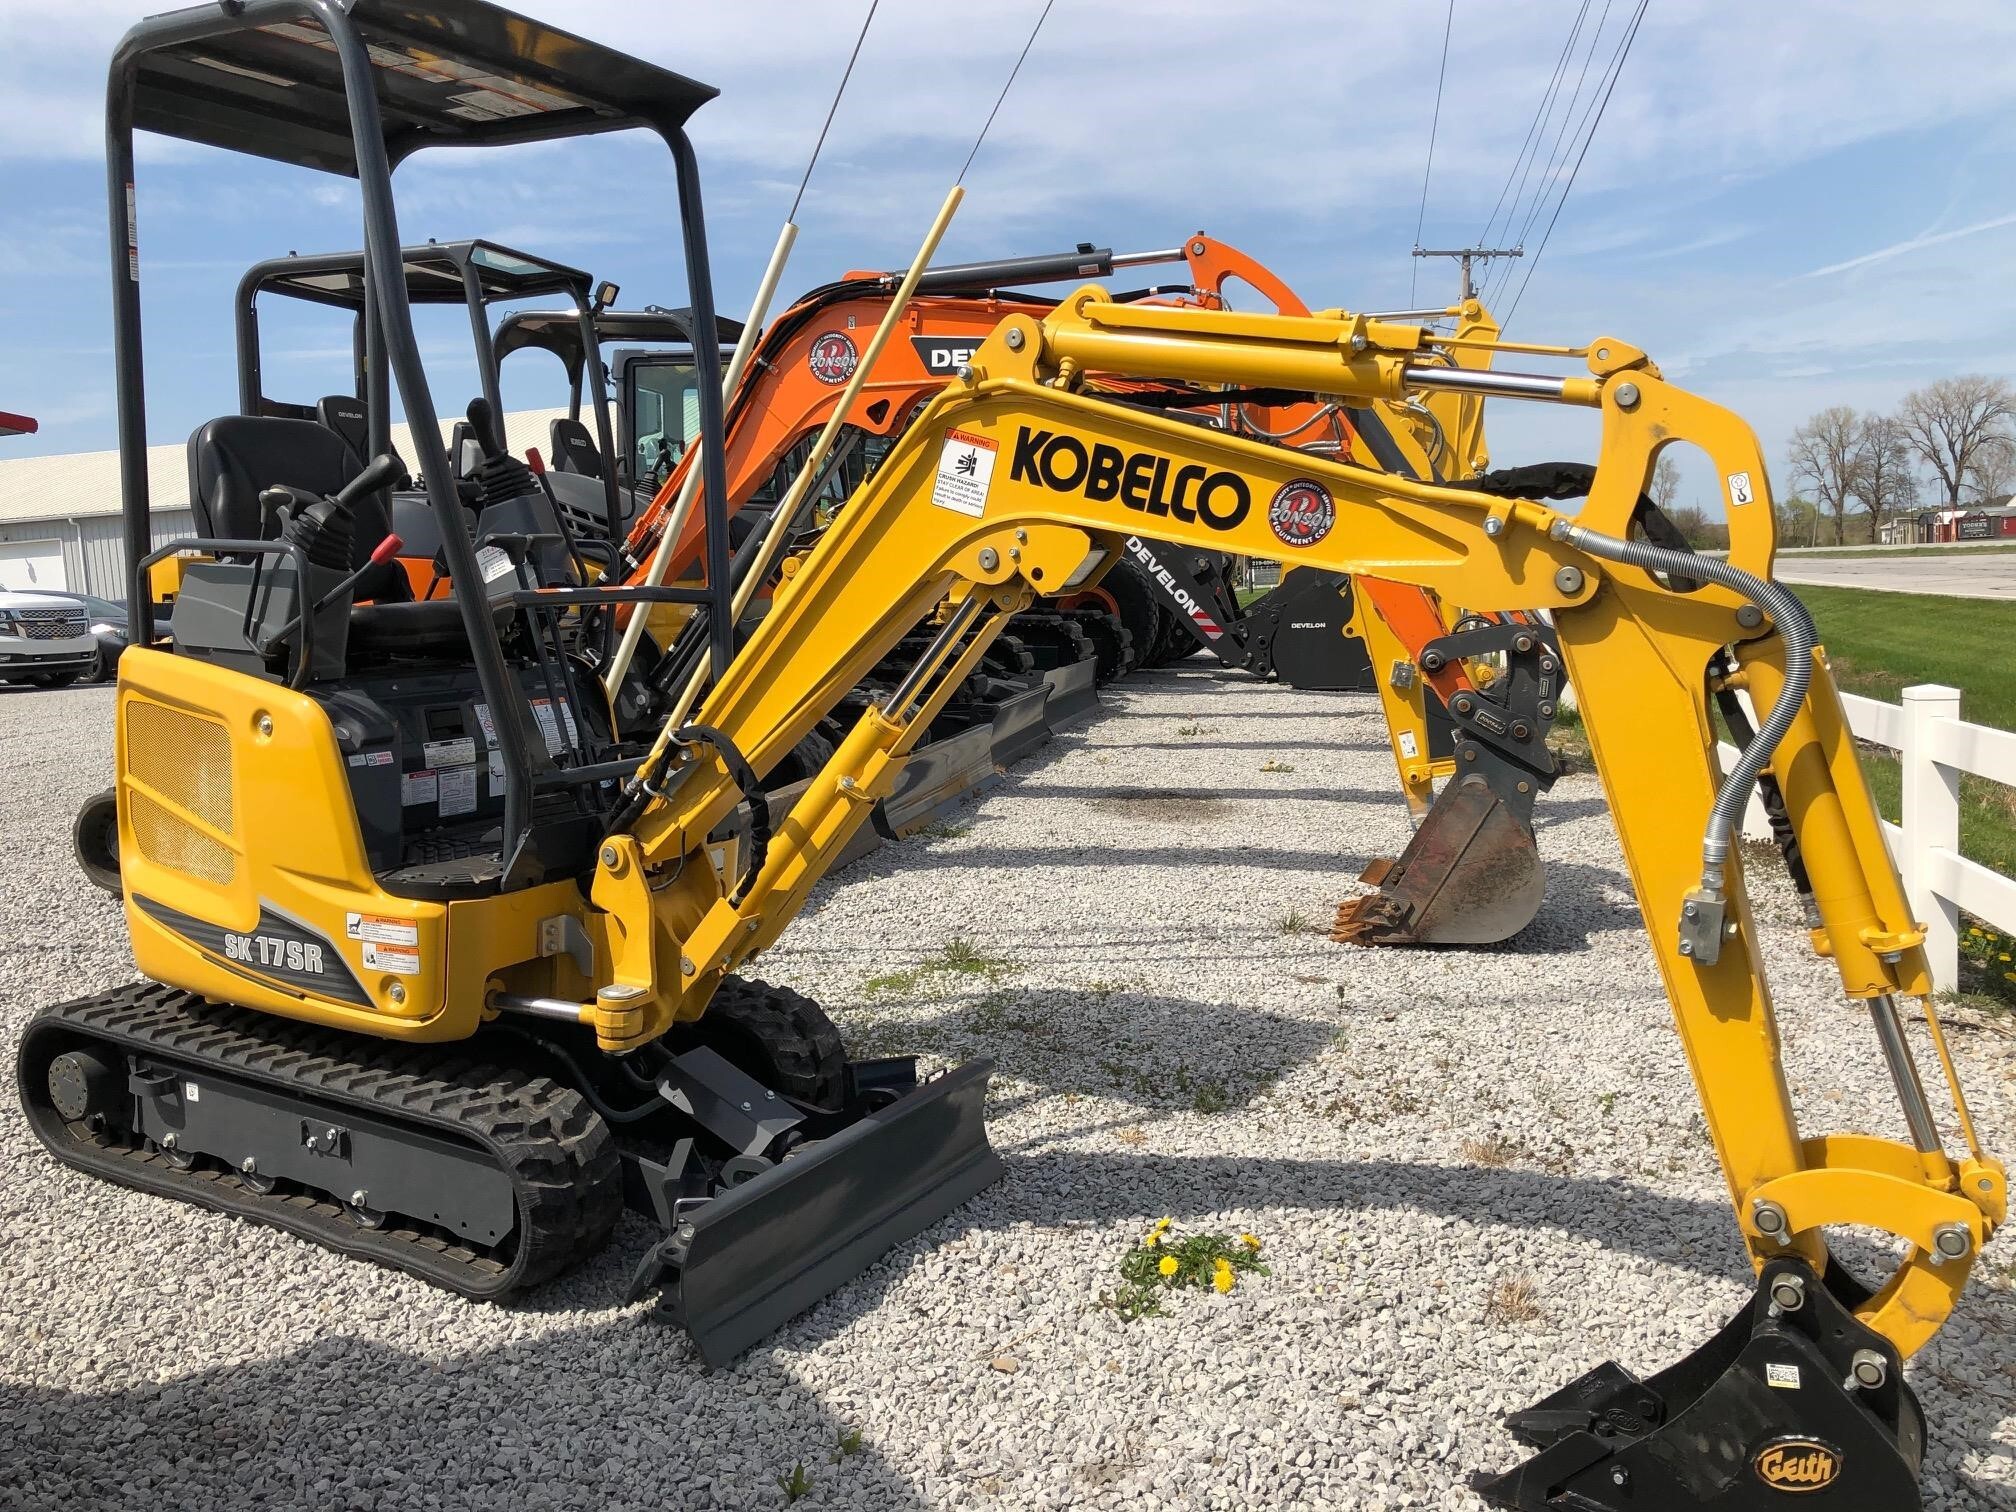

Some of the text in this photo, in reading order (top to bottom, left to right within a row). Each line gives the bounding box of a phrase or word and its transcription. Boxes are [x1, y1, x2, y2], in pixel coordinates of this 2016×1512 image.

[809, 357, 859, 368] RONSON
[812, 368, 846, 383] EQUIPMENT
[960, 434, 990, 448] WARNING
[938, 473, 956, 482] CRUSH
[949, 482, 964, 490] CLEAR
[1010, 425, 1251, 530] KOBELCO
[936, 485, 950, 493] Failure
[955, 492, 969, 500] comply
[1273, 482, 1332, 514] QUALITY INTEGRITY SERVICE
[1268, 508, 1336, 528] RONSON
[1272, 521, 1313, 544] EQUIPMENT
[1126, 536, 1200, 616] DEVELON
[224, 934, 324, 974] SK 17SR
[1762, 1450, 1832, 1482] Geith
